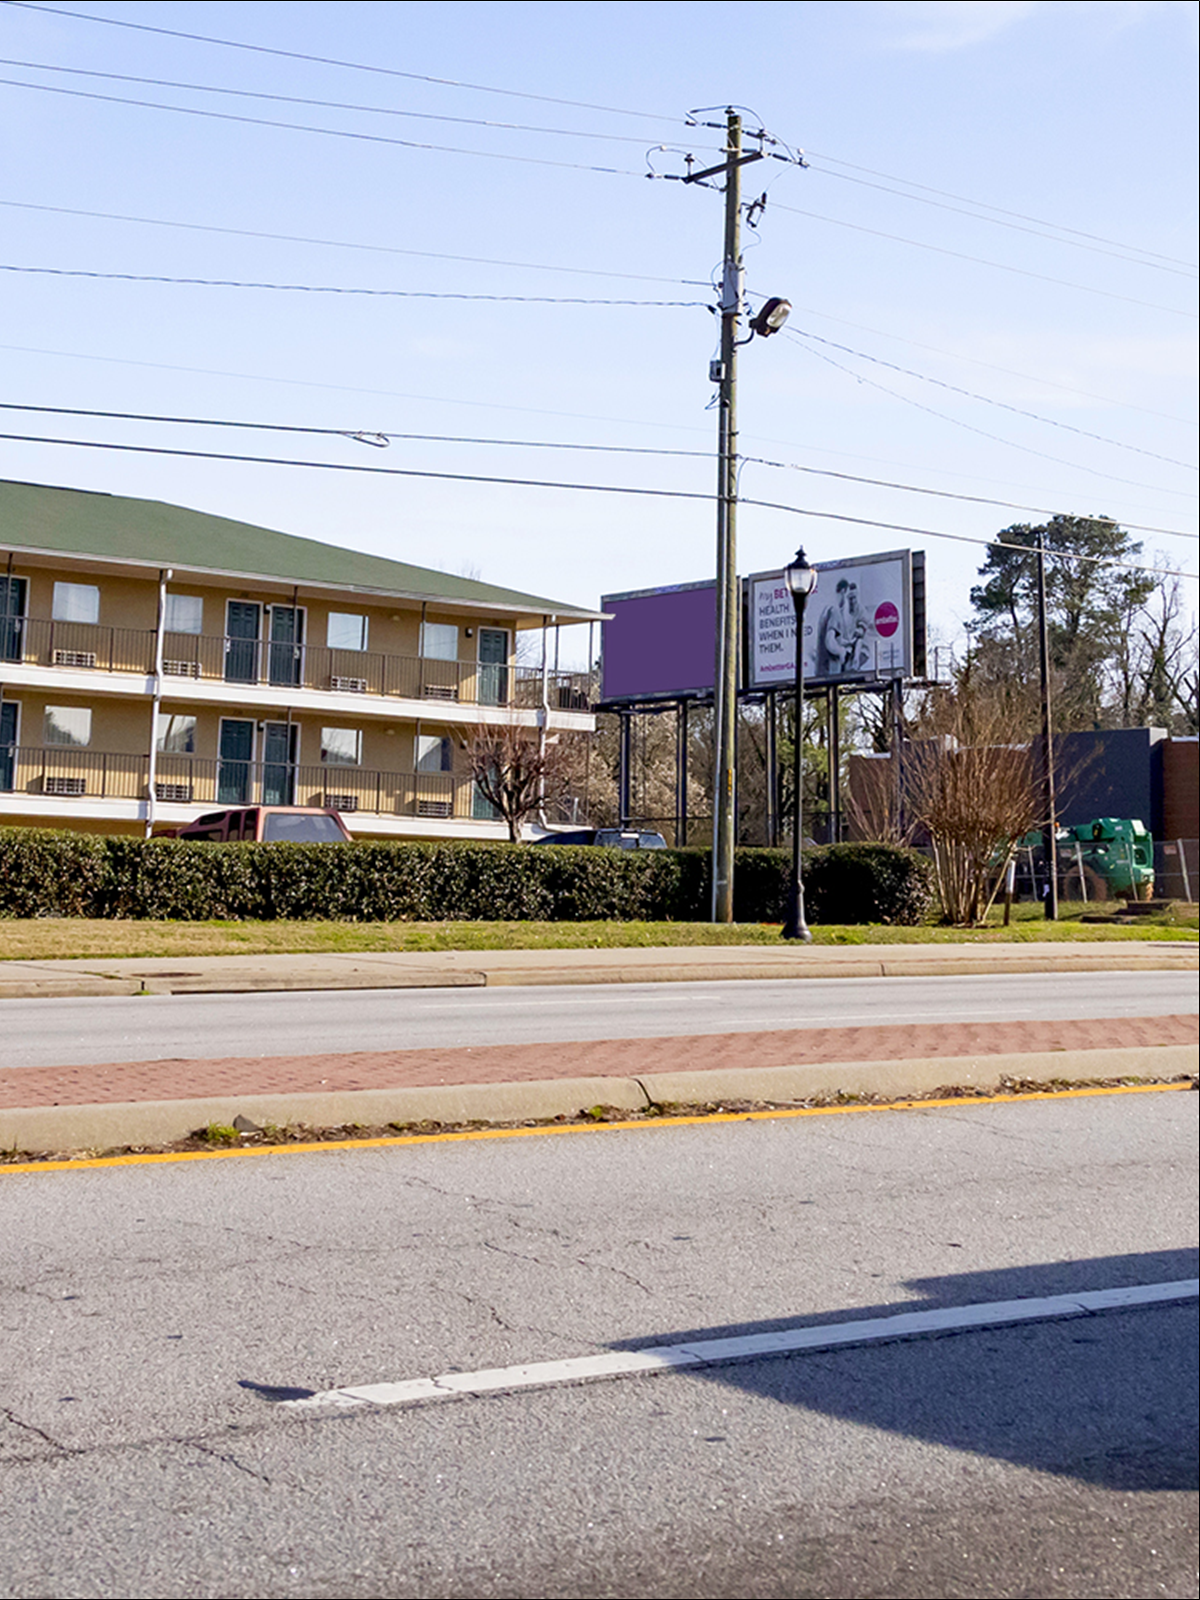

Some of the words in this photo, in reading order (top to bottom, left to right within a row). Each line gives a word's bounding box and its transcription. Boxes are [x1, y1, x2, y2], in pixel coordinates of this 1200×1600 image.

[759, 603, 790, 616] HEALTH
[759, 615, 797, 629] BENEFITS
[759, 628, 784, 641] WHEN
[786, 628, 789, 638] I
[790, 625, 813, 638] NED
[759, 642, 784, 654] THEM.
